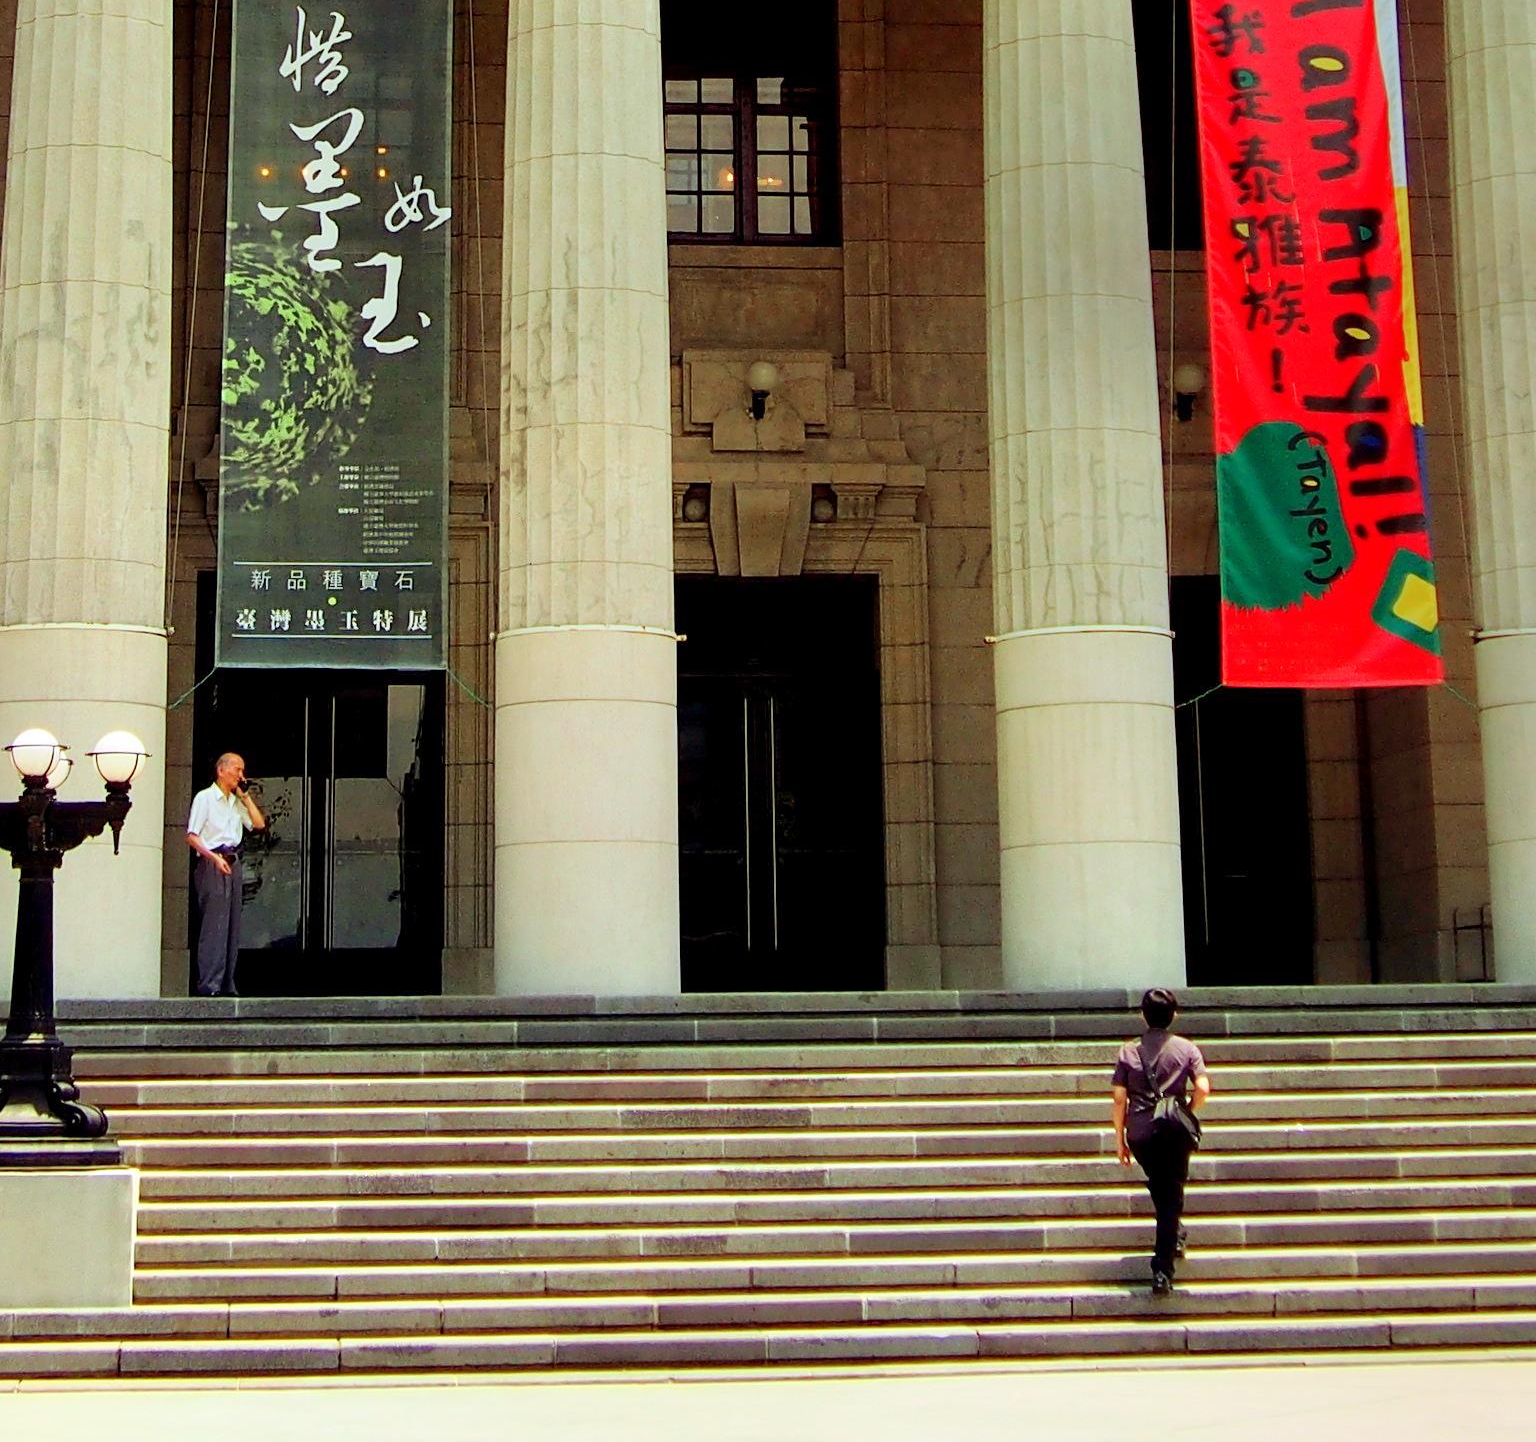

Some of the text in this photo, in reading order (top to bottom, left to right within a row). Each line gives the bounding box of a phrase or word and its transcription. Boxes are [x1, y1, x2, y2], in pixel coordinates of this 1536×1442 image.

[1298, 44, 1361, 182] am
[250, 569, 415, 592] 新品種寶石
[235, 608, 429, 633] 臺灣墨玉特展
